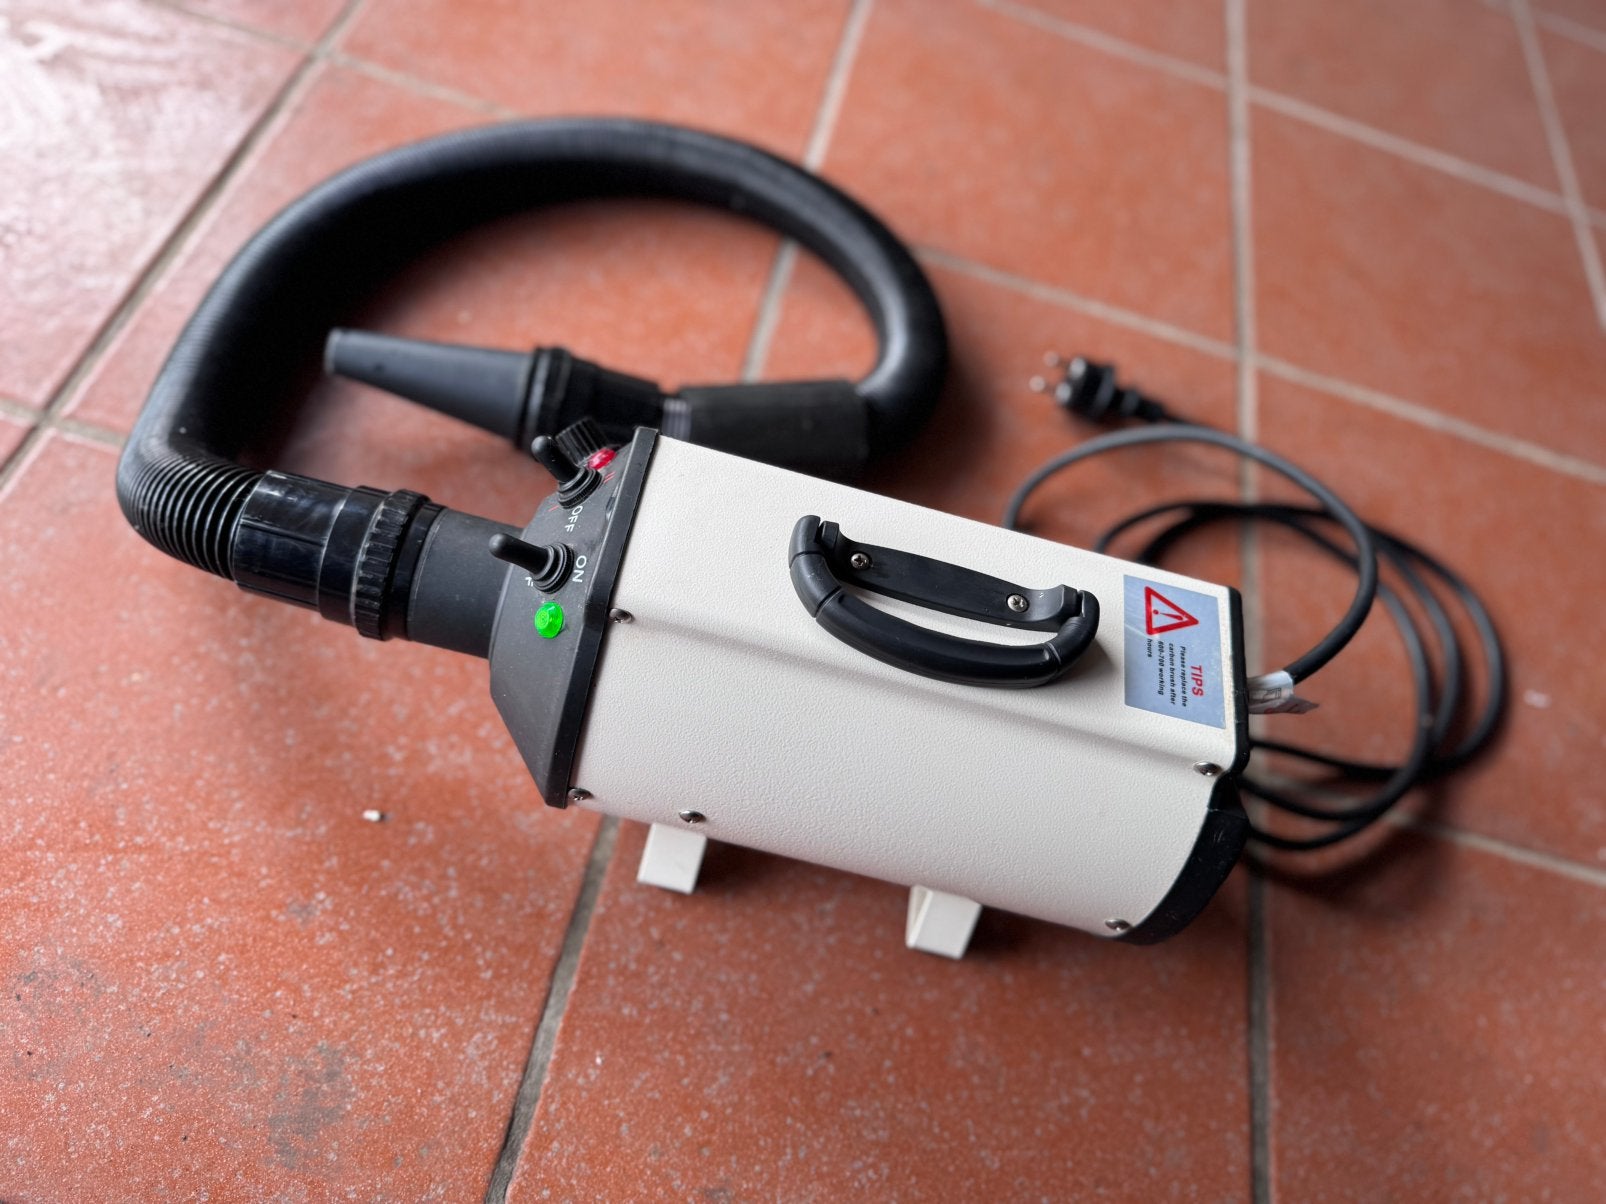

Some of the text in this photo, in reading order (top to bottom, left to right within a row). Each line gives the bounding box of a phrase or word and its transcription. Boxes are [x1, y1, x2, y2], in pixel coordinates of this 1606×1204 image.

[564, 505, 584, 532] OFF
[572, 555, 587, 583] ON
[1157, 668, 1165, 696] working
[1180, 669, 1188, 695] replace
[1190, 665, 1204, 696] TIPS
